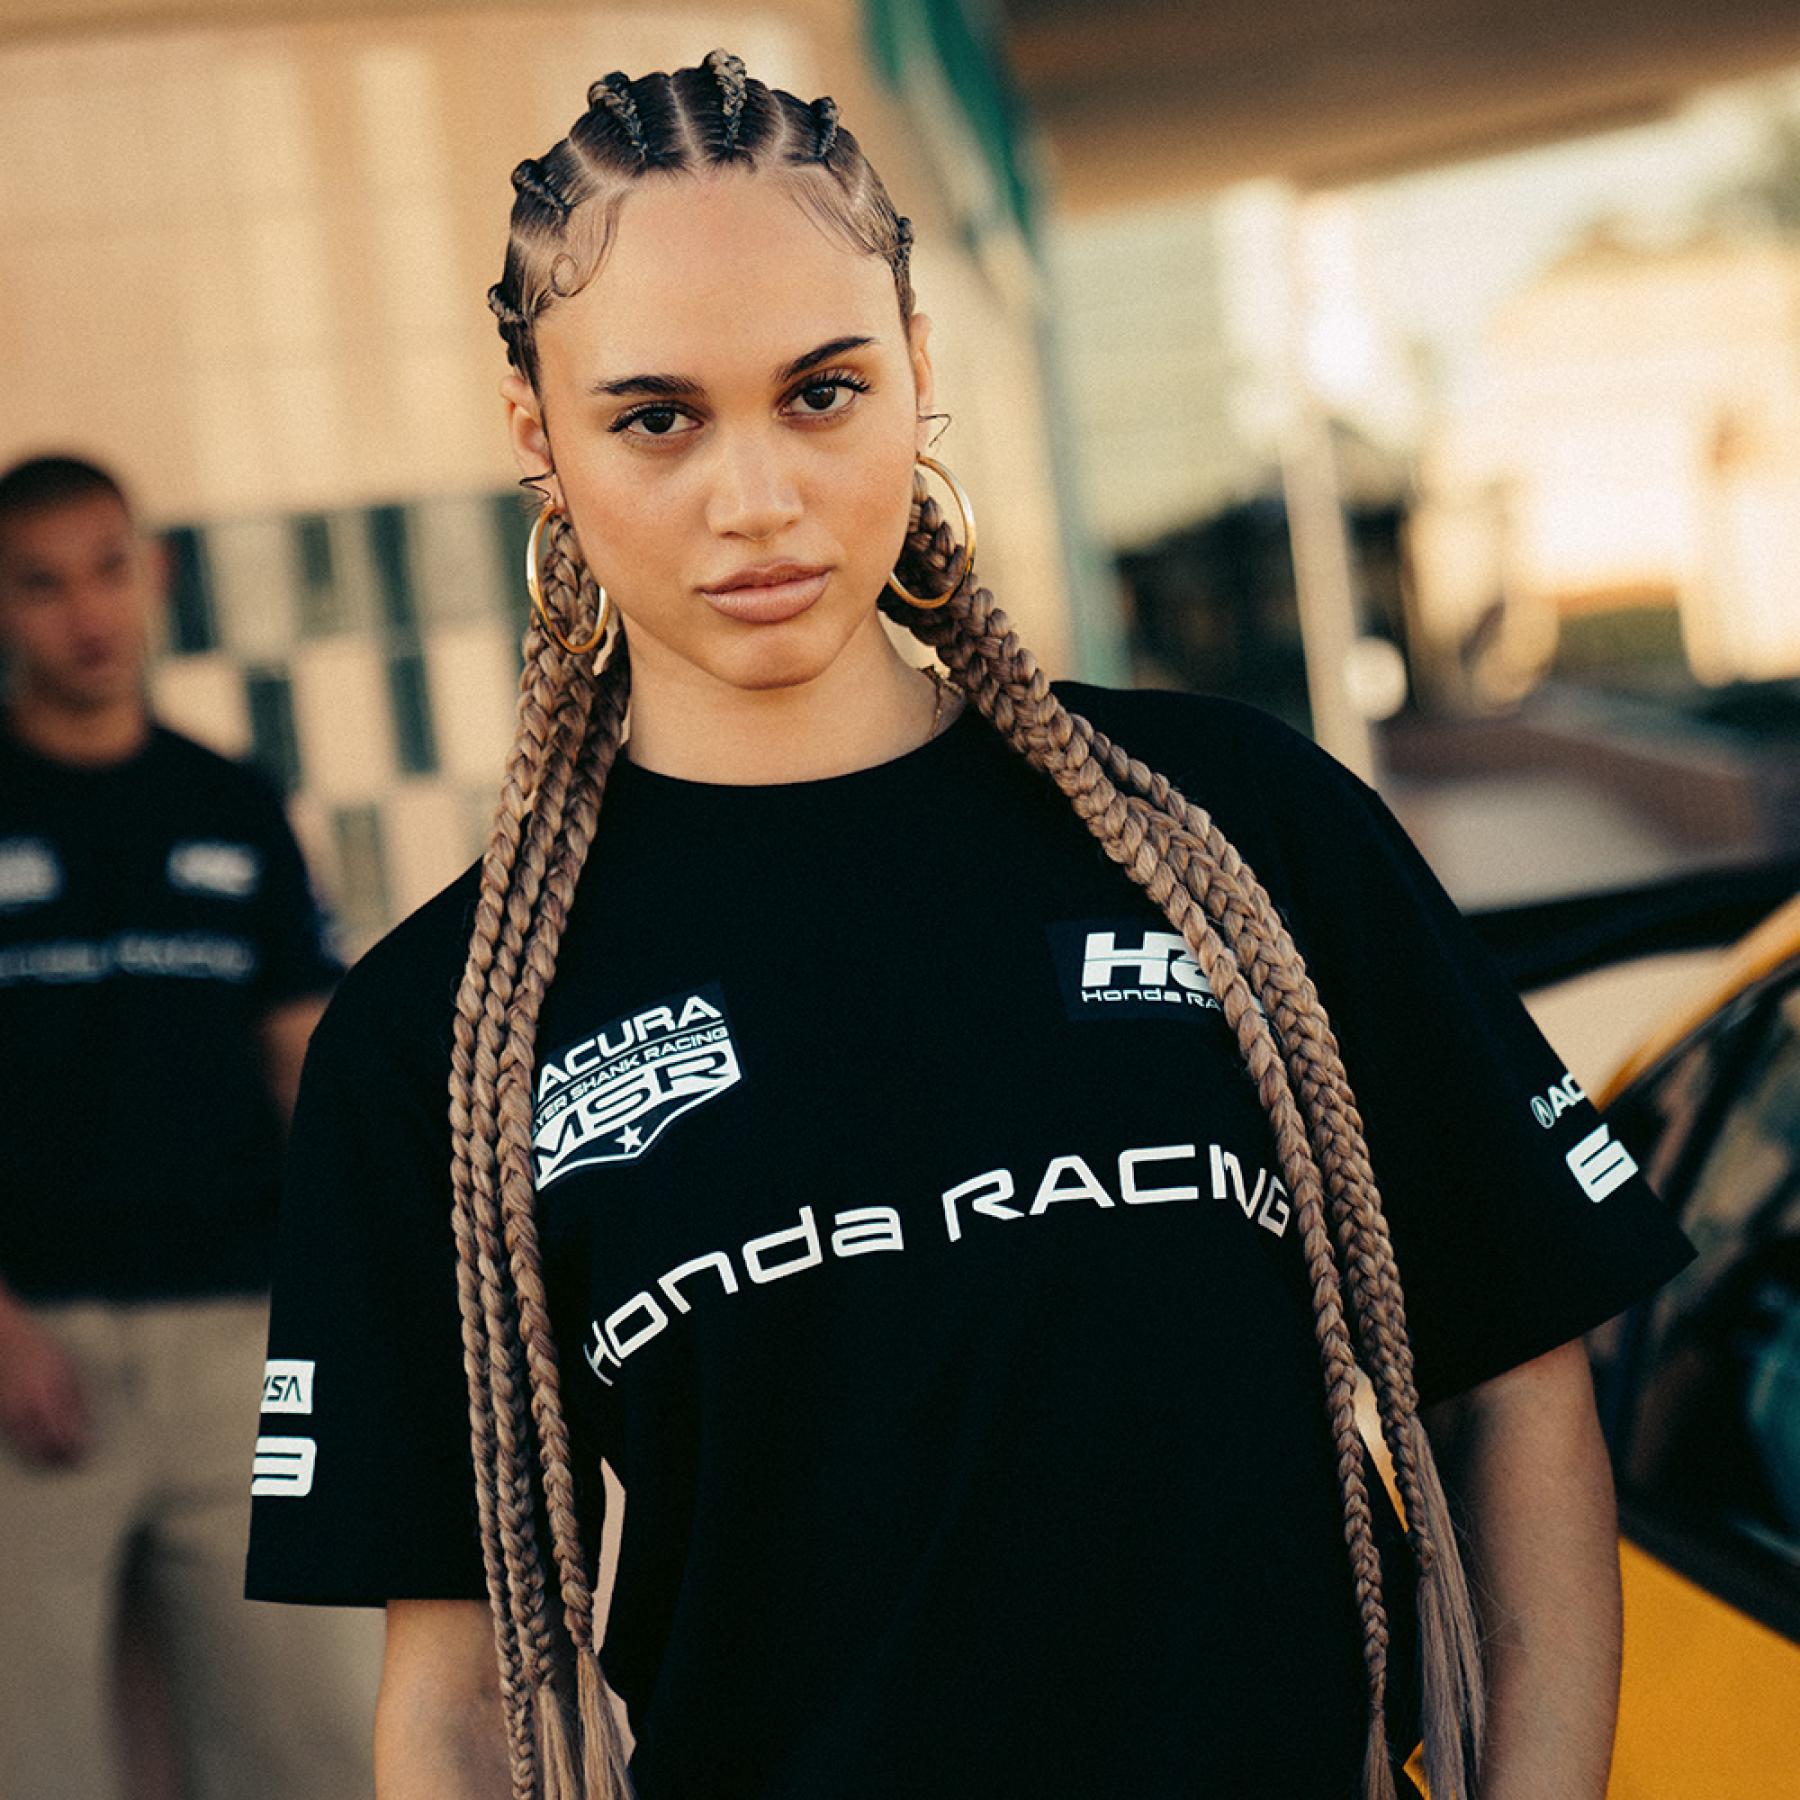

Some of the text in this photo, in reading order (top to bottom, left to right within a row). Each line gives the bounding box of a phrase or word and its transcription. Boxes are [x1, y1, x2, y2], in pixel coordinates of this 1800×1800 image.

[538, 995, 722, 1103] ACURA
[1082, 988, 1221, 1011] Honda RA
[532, 1050, 731, 1178] MSR
[535, 1025, 729, 1127] YER SHANK RACING
[1547, 1072, 1587, 1119] AC
[583, 1143, 1291, 1387] Honda RACING
[263, 1375, 303, 1403] SA
